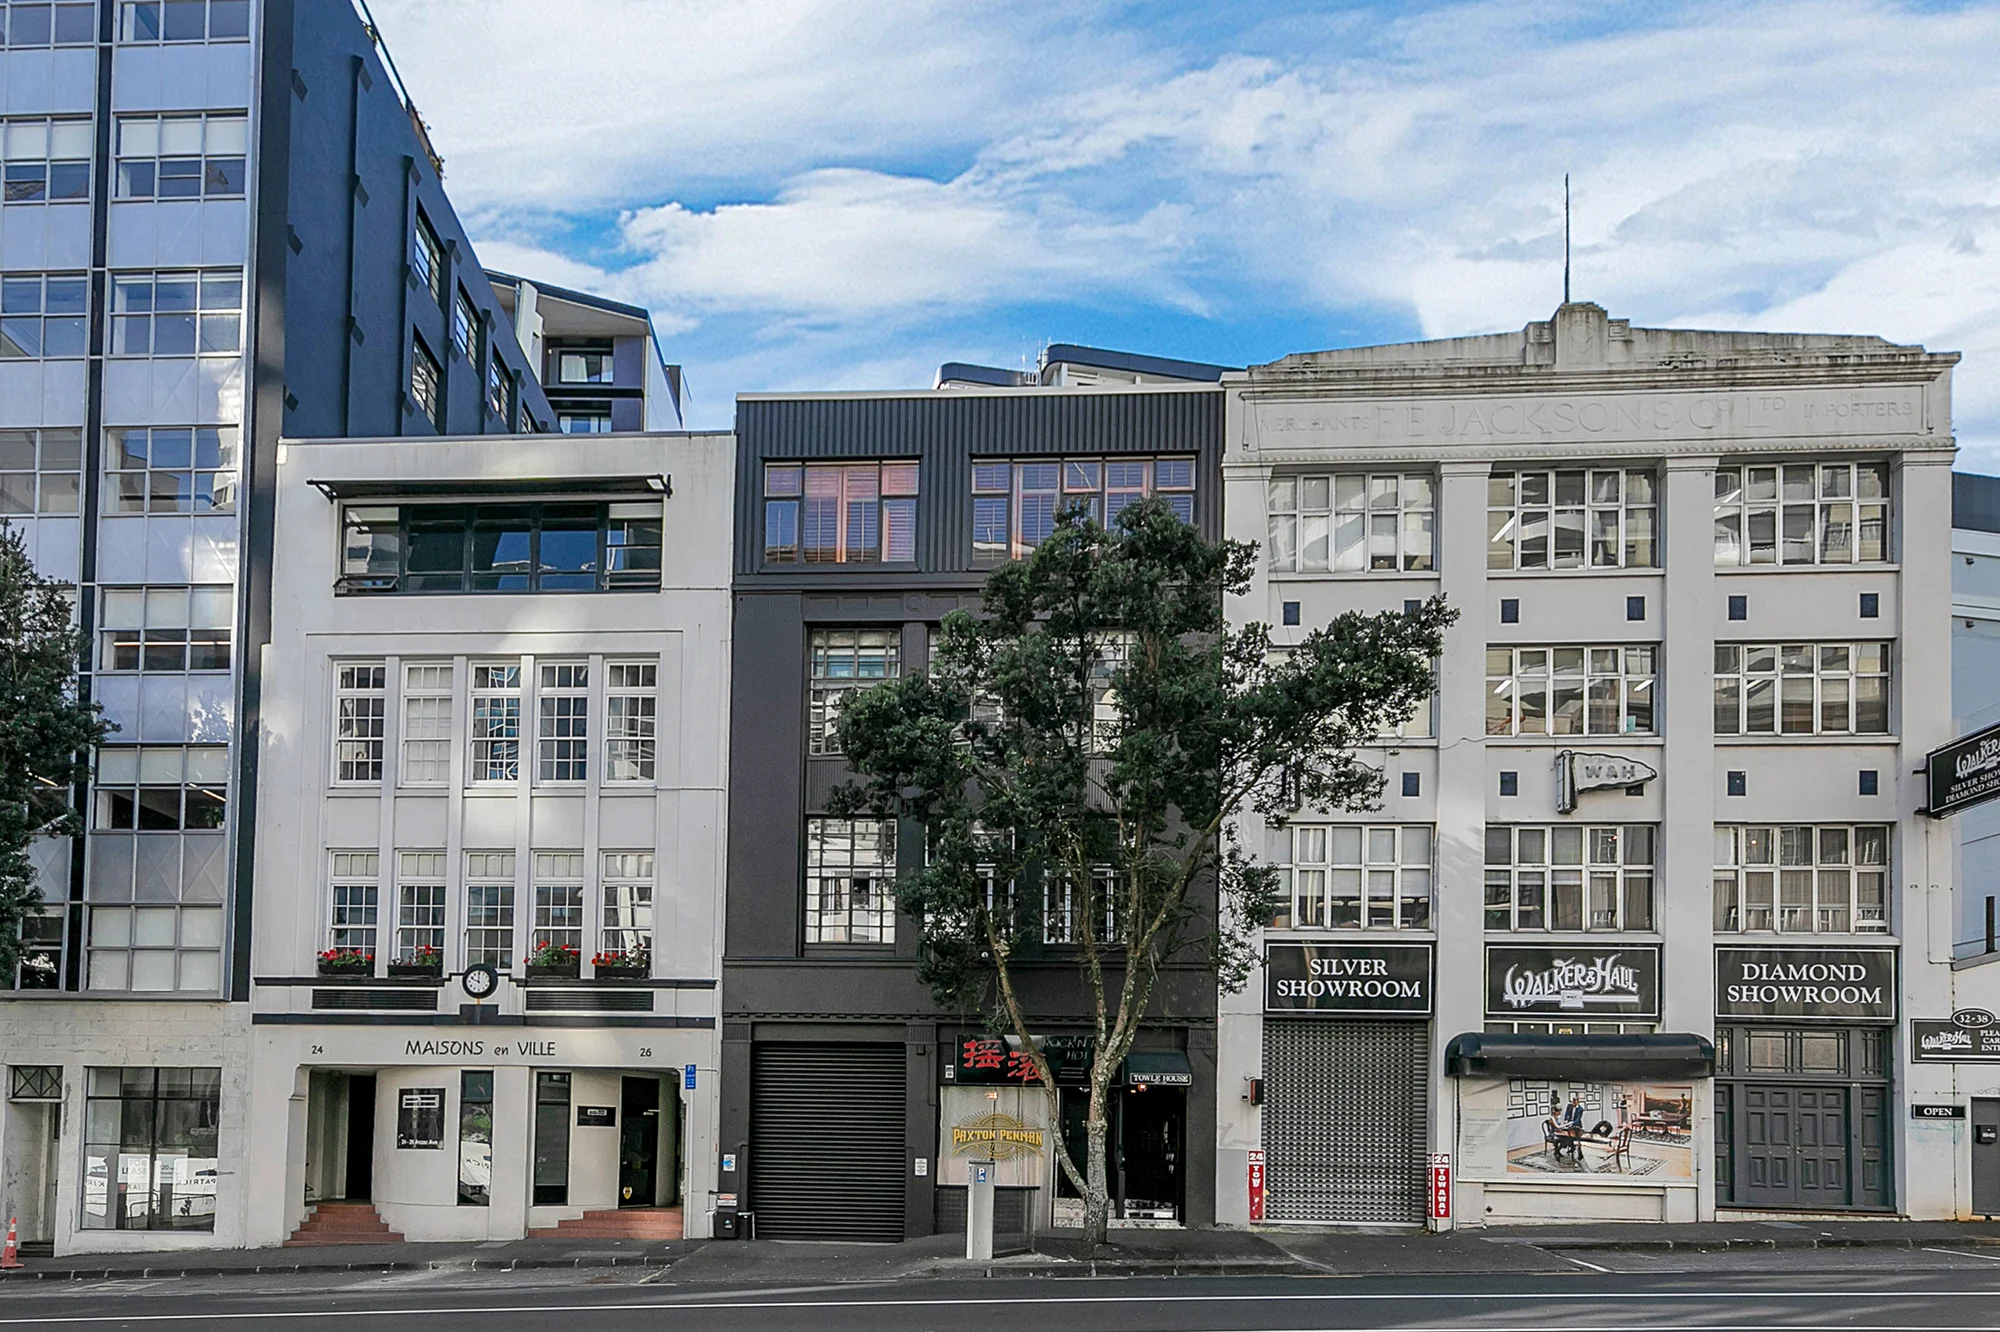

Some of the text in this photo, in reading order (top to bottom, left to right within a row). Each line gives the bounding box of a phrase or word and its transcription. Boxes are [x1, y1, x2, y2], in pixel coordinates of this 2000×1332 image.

[1441, 400, 1644, 438] JACKSON
[1950, 777, 1978, 793] SILVER
[1945, 784, 1985, 803] DIAMOND
[1310, 958, 1388, 976] SILVER
[1741, 963, 1867, 983] DIAMOND
[1277, 980, 1421, 999] SHOWROOM
[1727, 985, 1882, 1005] SHOWROOM
[1959, 1014, 1989, 1023] 32-38
[312, 1045, 323, 1055] 24
[405, 1041, 556, 1056] MAISONS en VILLE
[640, 1047, 652, 1057] 26
[1133, 1073, 1161, 1082] TOWLE
[1163, 1073, 1189, 1083] HOUSE
[1923, 1107, 1953, 1116] OPEN
[953, 1128, 1043, 1146] PAXTON PENMAN
[129, 1159, 147, 1167] FOR
[1249, 1152, 1263, 1161] 24
[1434, 1155, 1449, 1164] 24
[978, 1167, 985, 1176] P
[1252, 1165, 1261, 1187] TOW
[1437, 1168, 1447, 1188] TOW
[1437, 1189, 1447, 1215] AWAY
